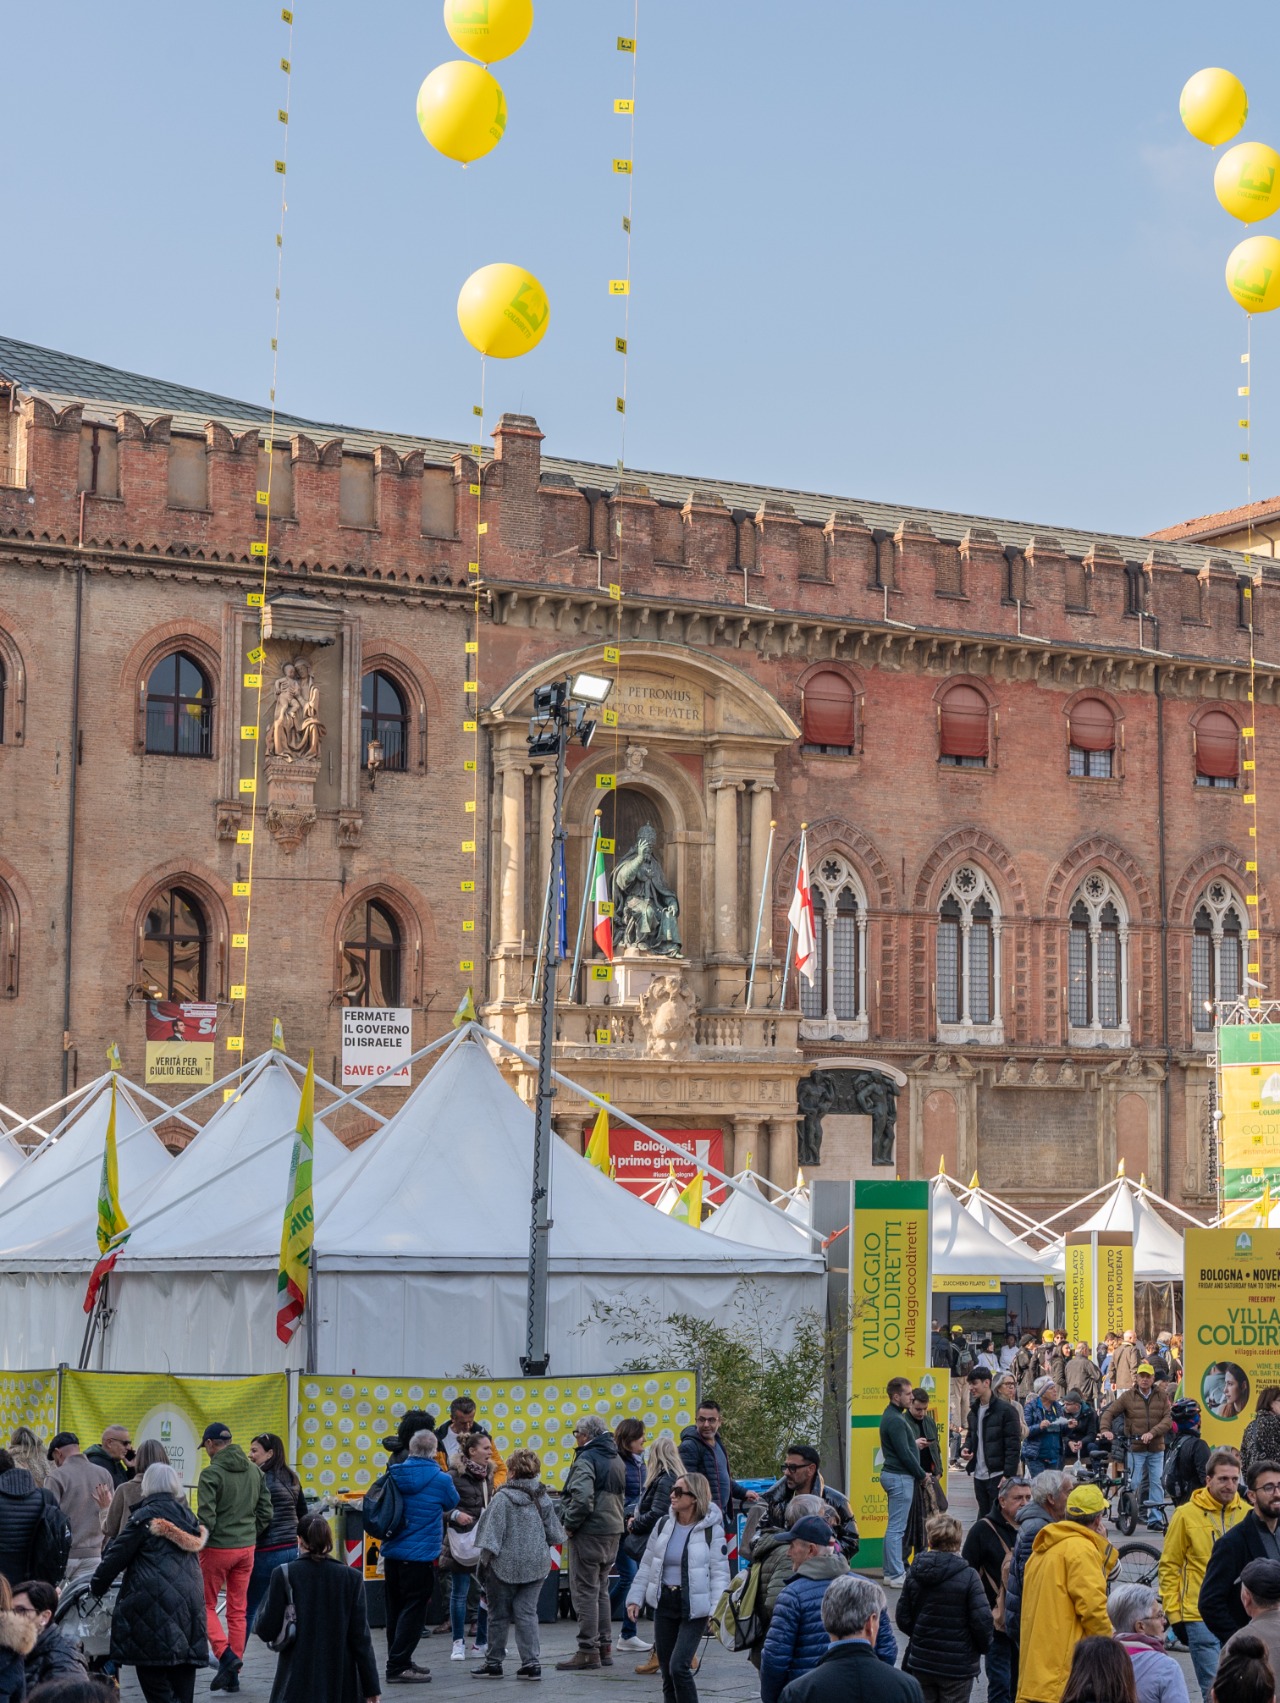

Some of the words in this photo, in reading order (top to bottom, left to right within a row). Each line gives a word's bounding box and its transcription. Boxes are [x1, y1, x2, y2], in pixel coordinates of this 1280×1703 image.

[503, 308, 532, 340] COLDIRETTI
[628, 686, 691, 701] PETRONIUS
[665, 707, 700, 720] PATER
[344, 1011, 395, 1021] FERMATE
[344, 1024, 353, 1033] IL
[356, 1024, 410, 1034] GOVERNO
[344, 1037, 355, 1046] DI
[357, 1037, 402, 1047] ISRAELE
[155, 1055, 180, 1066] VERITÀ
[182, 1057, 197, 1066] PER
[149, 1066, 174, 1075] GIULIO
[176, 1066, 203, 1075] REGENI
[344, 1065, 374, 1076] SAVE
[618, 1155, 652, 1168] primo
[1107, 1249, 1115, 1283] FILATO
[1115, 1249, 1124, 1291] MODENA
[1200, 1269, 1243, 1281] BOLOGNA
[863, 1232, 881, 1359] VILLAGGIO
[883, 1220, 902, 1359] COLDIRETTI
[905, 1220, 919, 1358] #villaggiocoldiretti
[1116, 1293, 1124, 1303] DI
[1072, 1287, 1080, 1342] ZUCCHERO
[1107, 1284, 1115, 1334] UCCHERO
